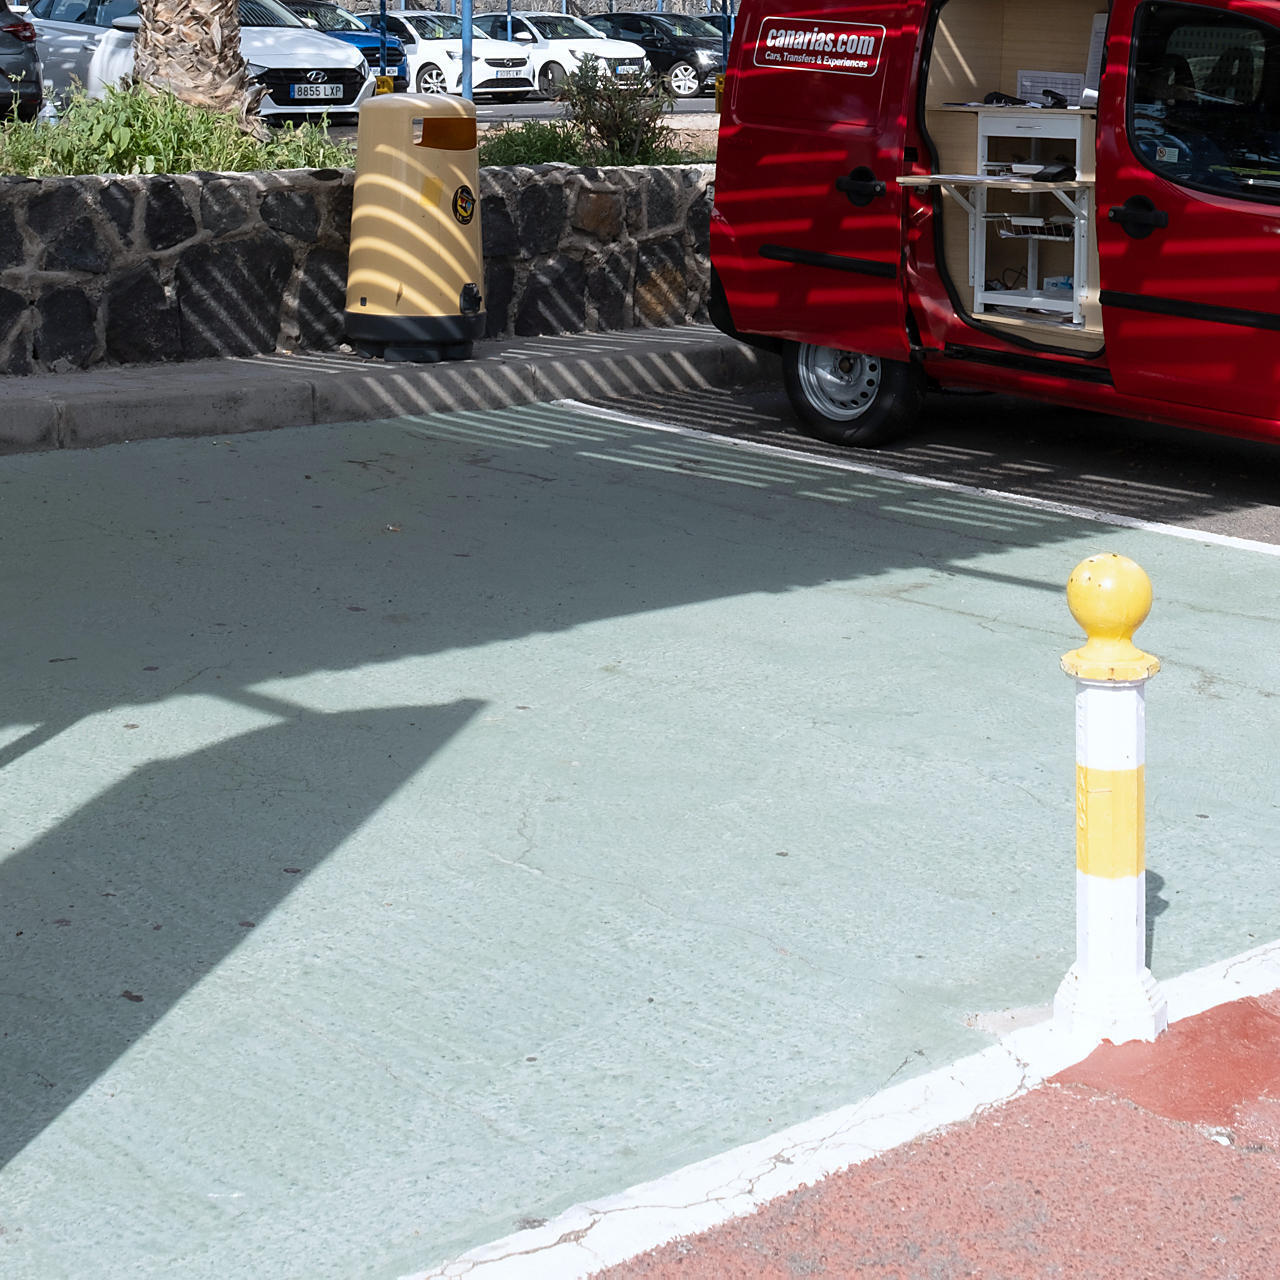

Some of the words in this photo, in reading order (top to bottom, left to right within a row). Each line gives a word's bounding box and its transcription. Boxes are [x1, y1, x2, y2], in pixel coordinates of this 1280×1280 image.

[766, 27, 875, 56] canarias.com
[765, 51, 782, 62] Cars,
[783, 52, 816, 64] Transfers
[816, 55, 823, 65] &
[823, 56, 868, 68] Experiences
[297, 86, 321, 97] 8855
[323, 86, 340, 97] LXP
